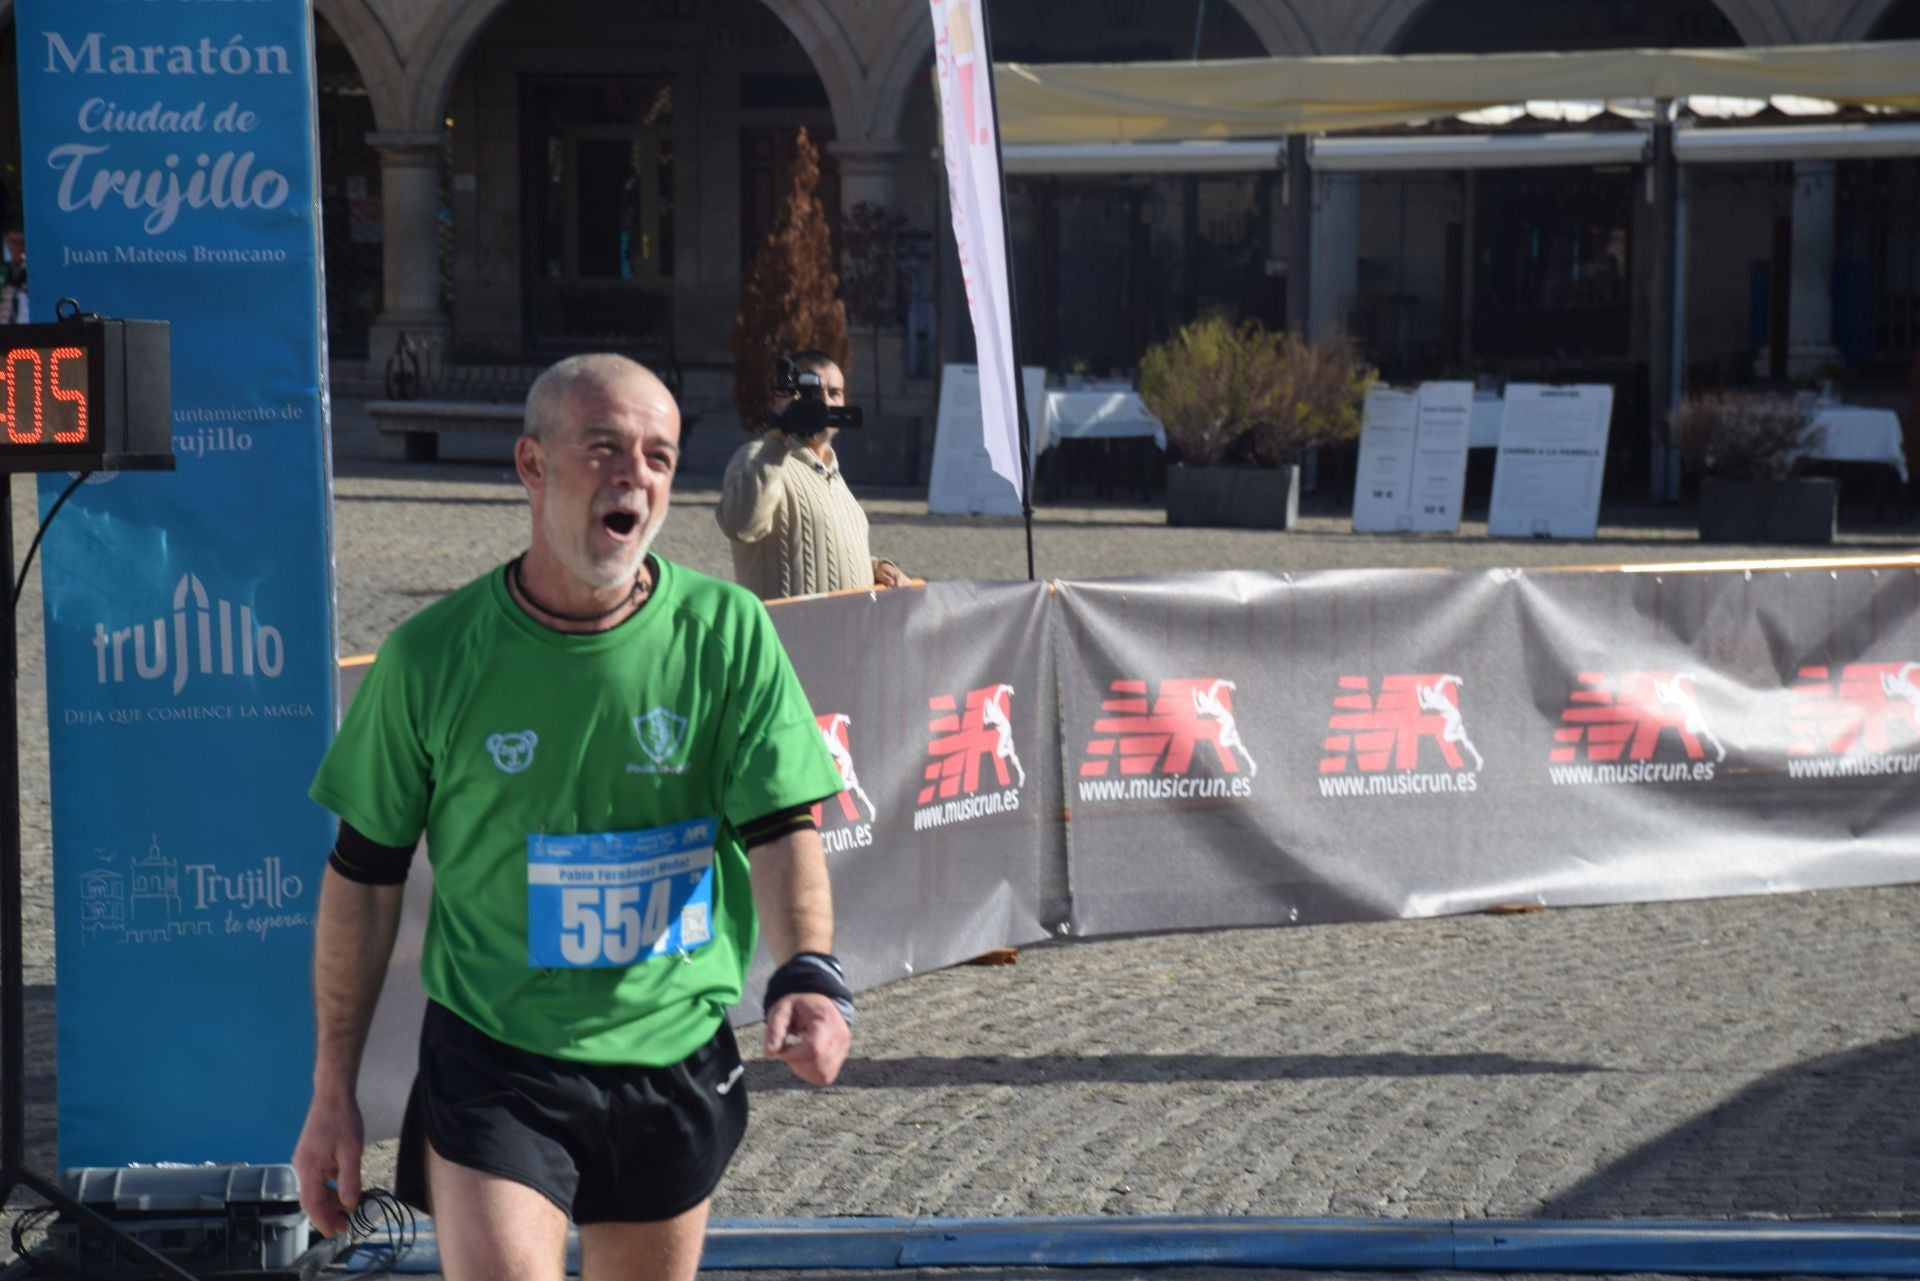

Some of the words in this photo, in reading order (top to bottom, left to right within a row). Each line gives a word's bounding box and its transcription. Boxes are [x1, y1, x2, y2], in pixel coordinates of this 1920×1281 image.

[42, 31, 293, 75] Maratón
[78, 97, 207, 133] Ciudad
[213, 101, 260, 133] de
[47, 143, 290, 236] Trujillo
[62, 246, 109, 267] Juan
[114, 246, 187, 263] Mateos
[194, 245, 287, 264] Broncano
[171, 405, 277, 423] untamiento
[281, 403, 304, 420] de
[92, 571, 285, 696] trujillo
[64, 708, 104, 726] DEJA
[109, 707, 143, 725] QUE
[147, 705, 234, 721] COMIENCE
[240, 704, 259, 718] LA
[263, 703, 314, 718] MAGIA
[1079, 775, 1251, 801] www.musicrun.es
[1318, 770, 1477, 797] www.musicrun.es
[1549, 760, 1714, 786] www.musicrun.es
[914, 788, 1019, 831] www.musicrun.es
[186, 856, 303, 909] Trujillo
[560, 869, 594, 881] Pablo
[560, 880, 670, 965] 554
